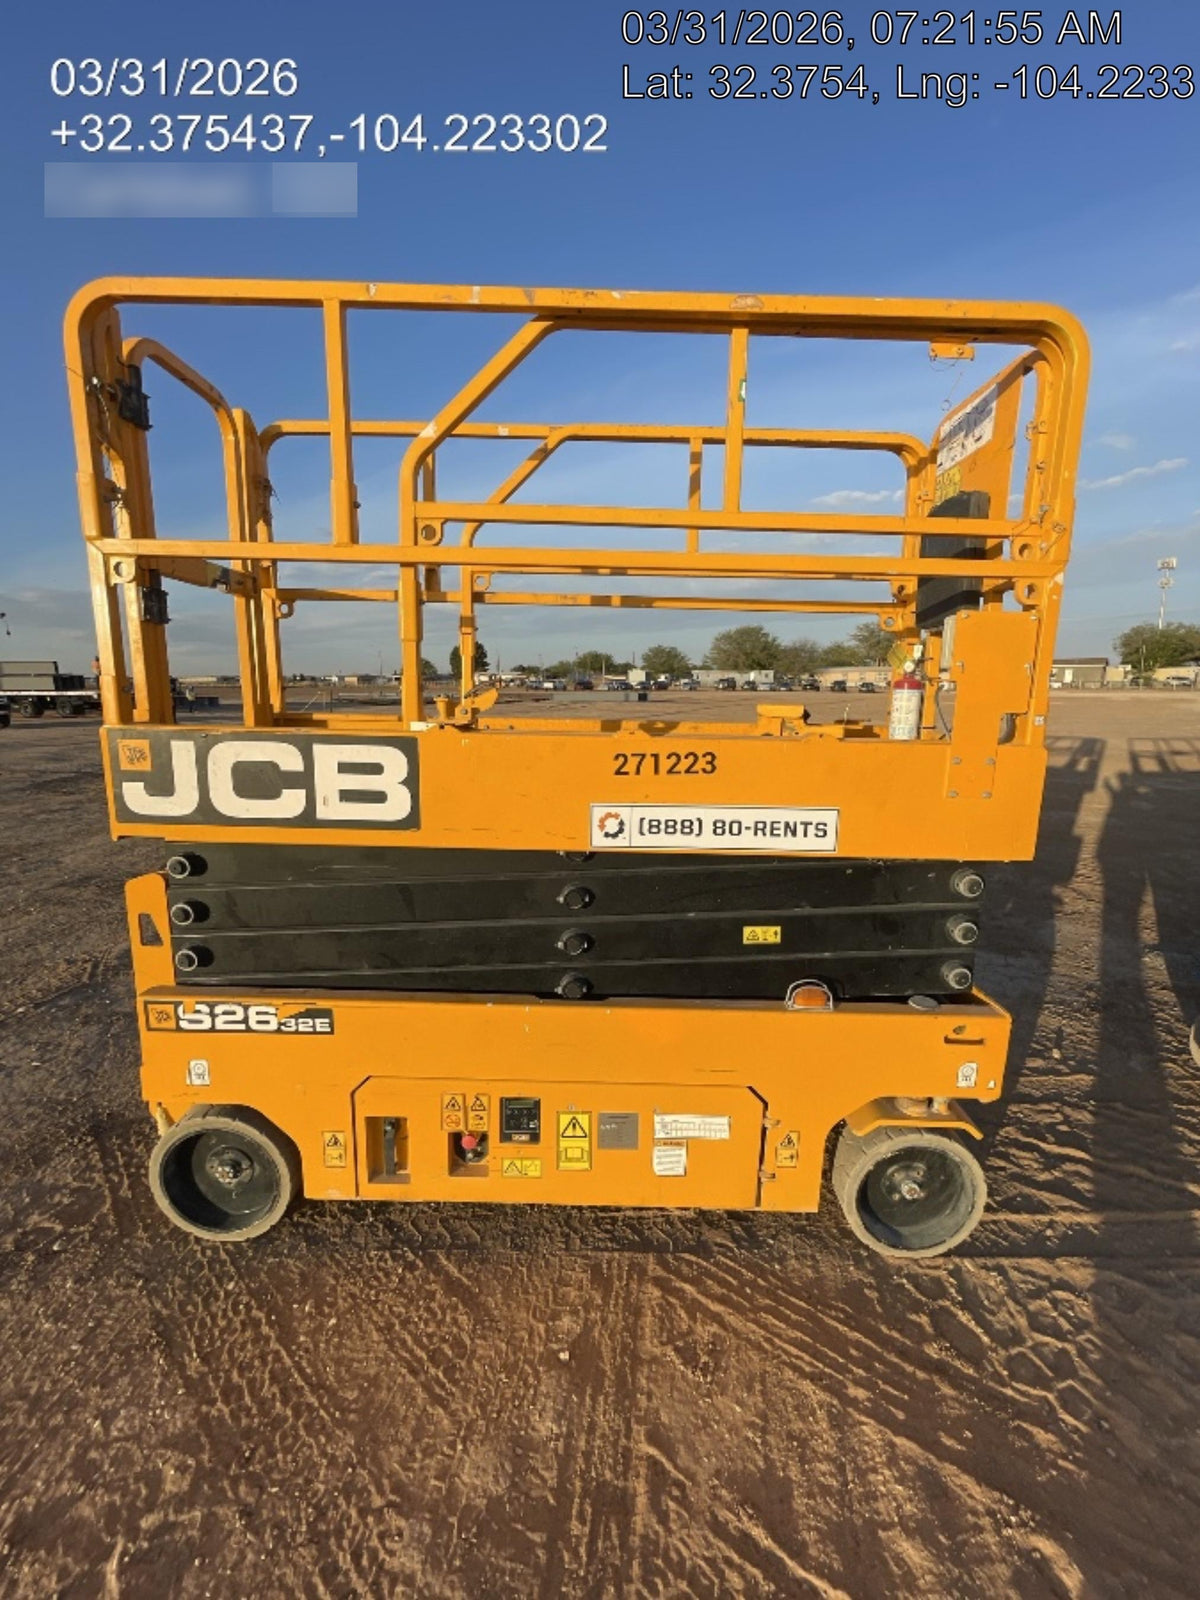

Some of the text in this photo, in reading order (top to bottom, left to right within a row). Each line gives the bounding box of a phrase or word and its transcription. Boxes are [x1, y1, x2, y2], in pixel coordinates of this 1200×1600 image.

[613, 751, 718, 776] 271223
[121, 740, 412, 822] JCB
[638, 816, 828, 838] (888) 80-RENTS
